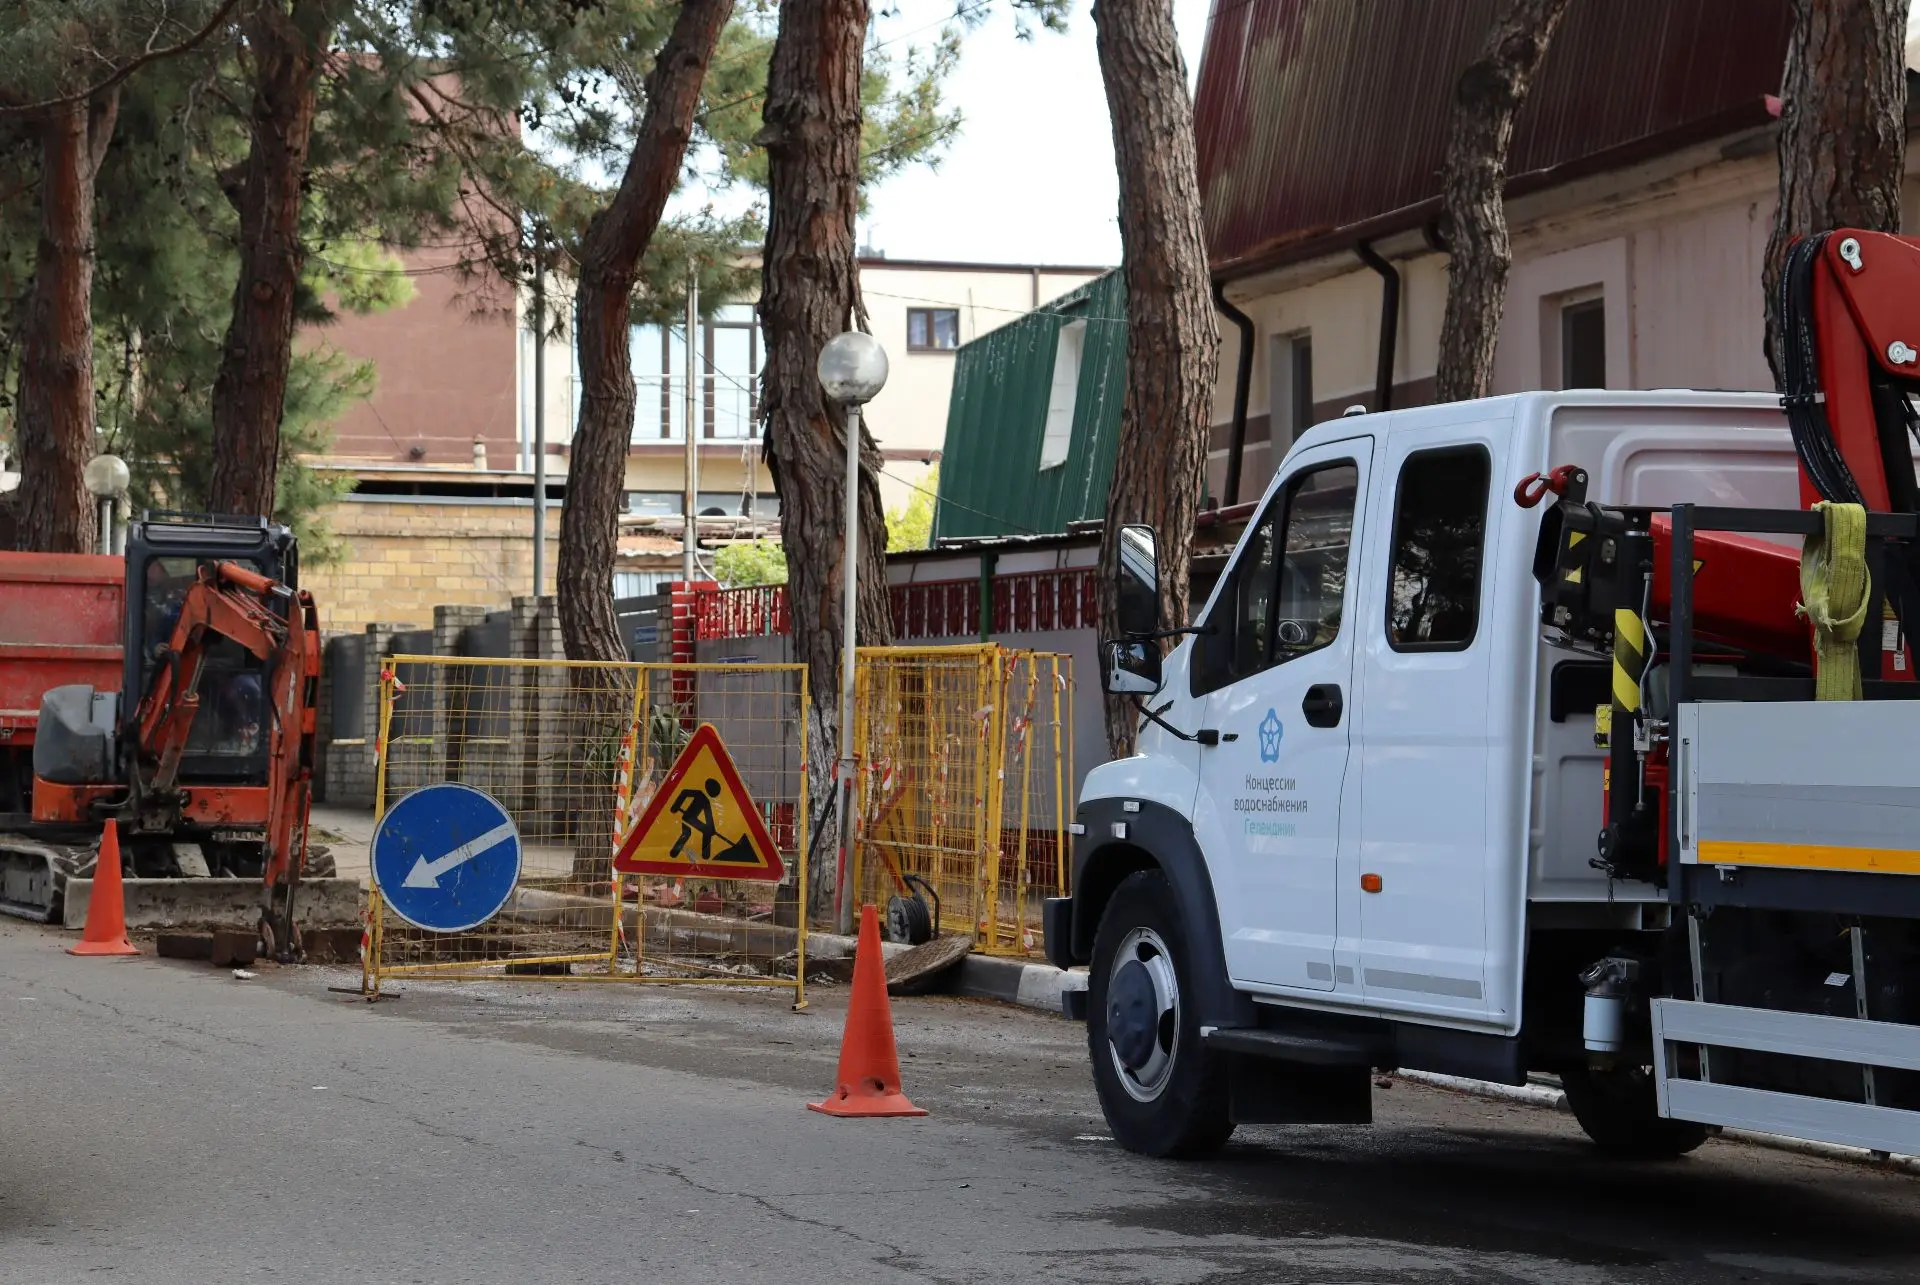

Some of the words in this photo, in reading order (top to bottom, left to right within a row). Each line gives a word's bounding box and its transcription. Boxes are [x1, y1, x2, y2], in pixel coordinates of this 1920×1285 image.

[1245, 774, 1296, 794] Концессии
[1234, 796, 1308, 814] водоснабжения
[1244, 818, 1296, 838] Геленджик
